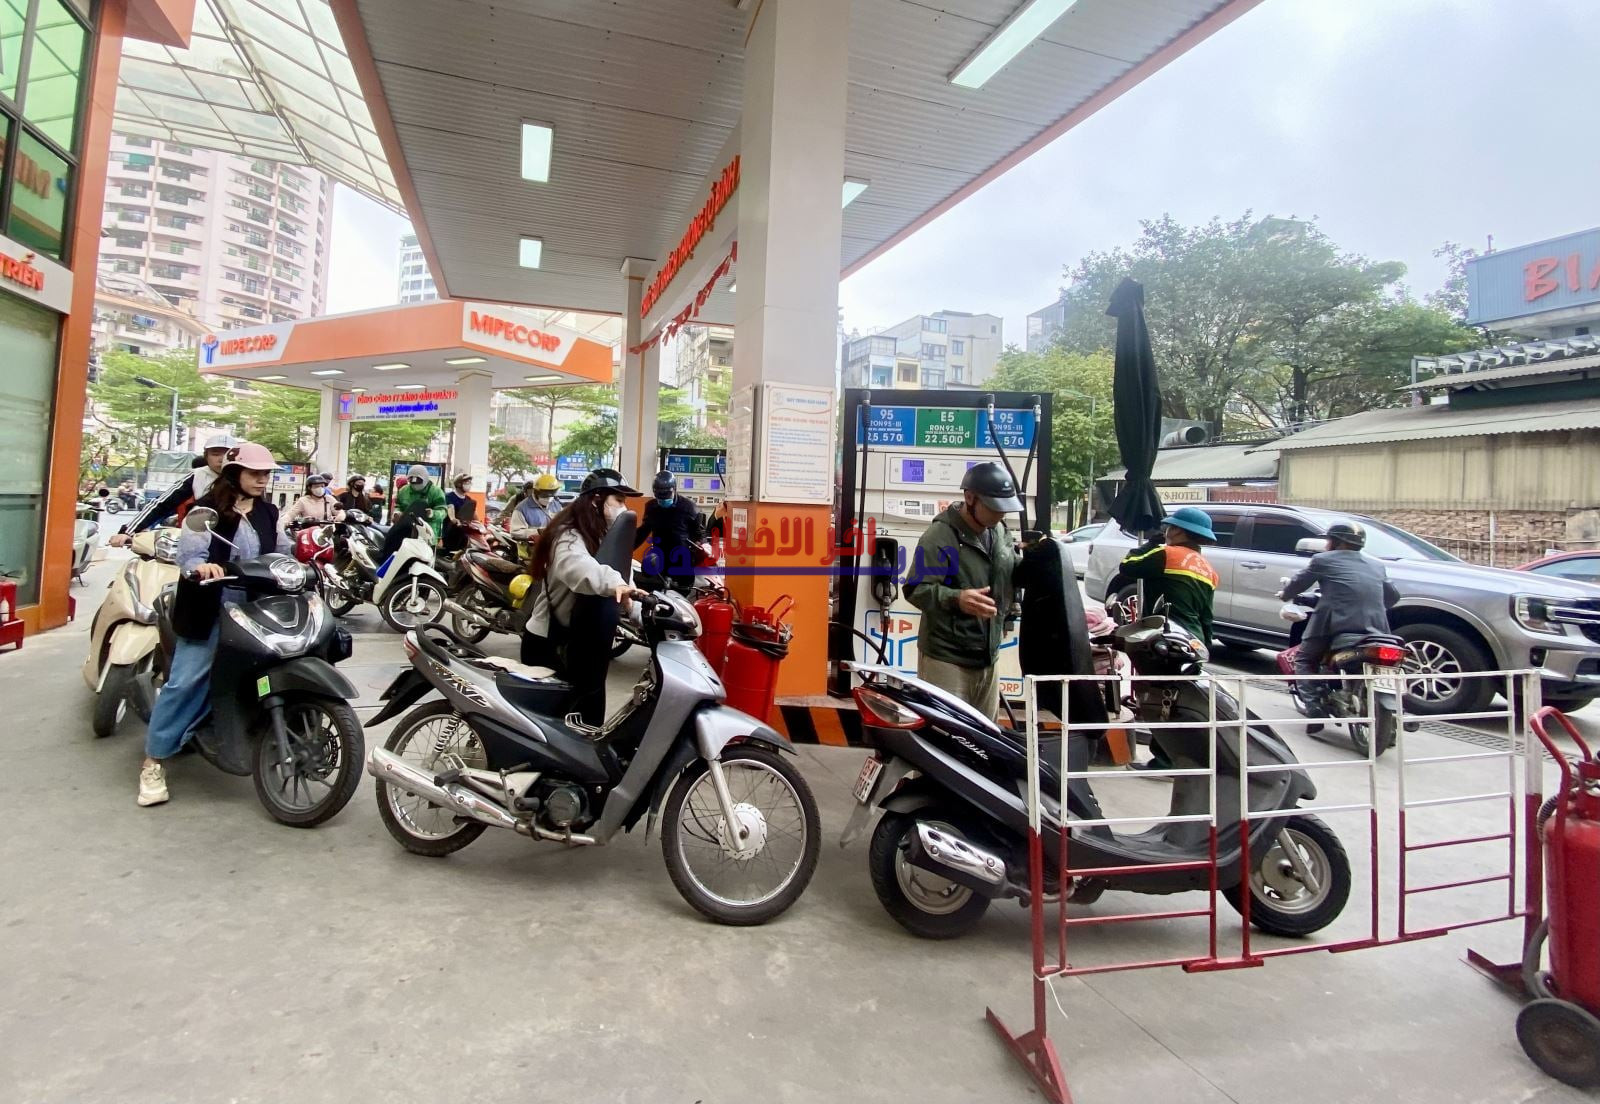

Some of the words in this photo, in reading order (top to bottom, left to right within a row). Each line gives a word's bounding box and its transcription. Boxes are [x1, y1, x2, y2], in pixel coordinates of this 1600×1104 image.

[469, 310, 561, 353] MIPECORP
[220, 334, 277, 356] MIPECORP
[880, 409, 894, 420] 95
[940, 411, 955, 423] E5
[999, 412, 1014, 424] 95
[1171, 491, 1203, 500] HOTEL
